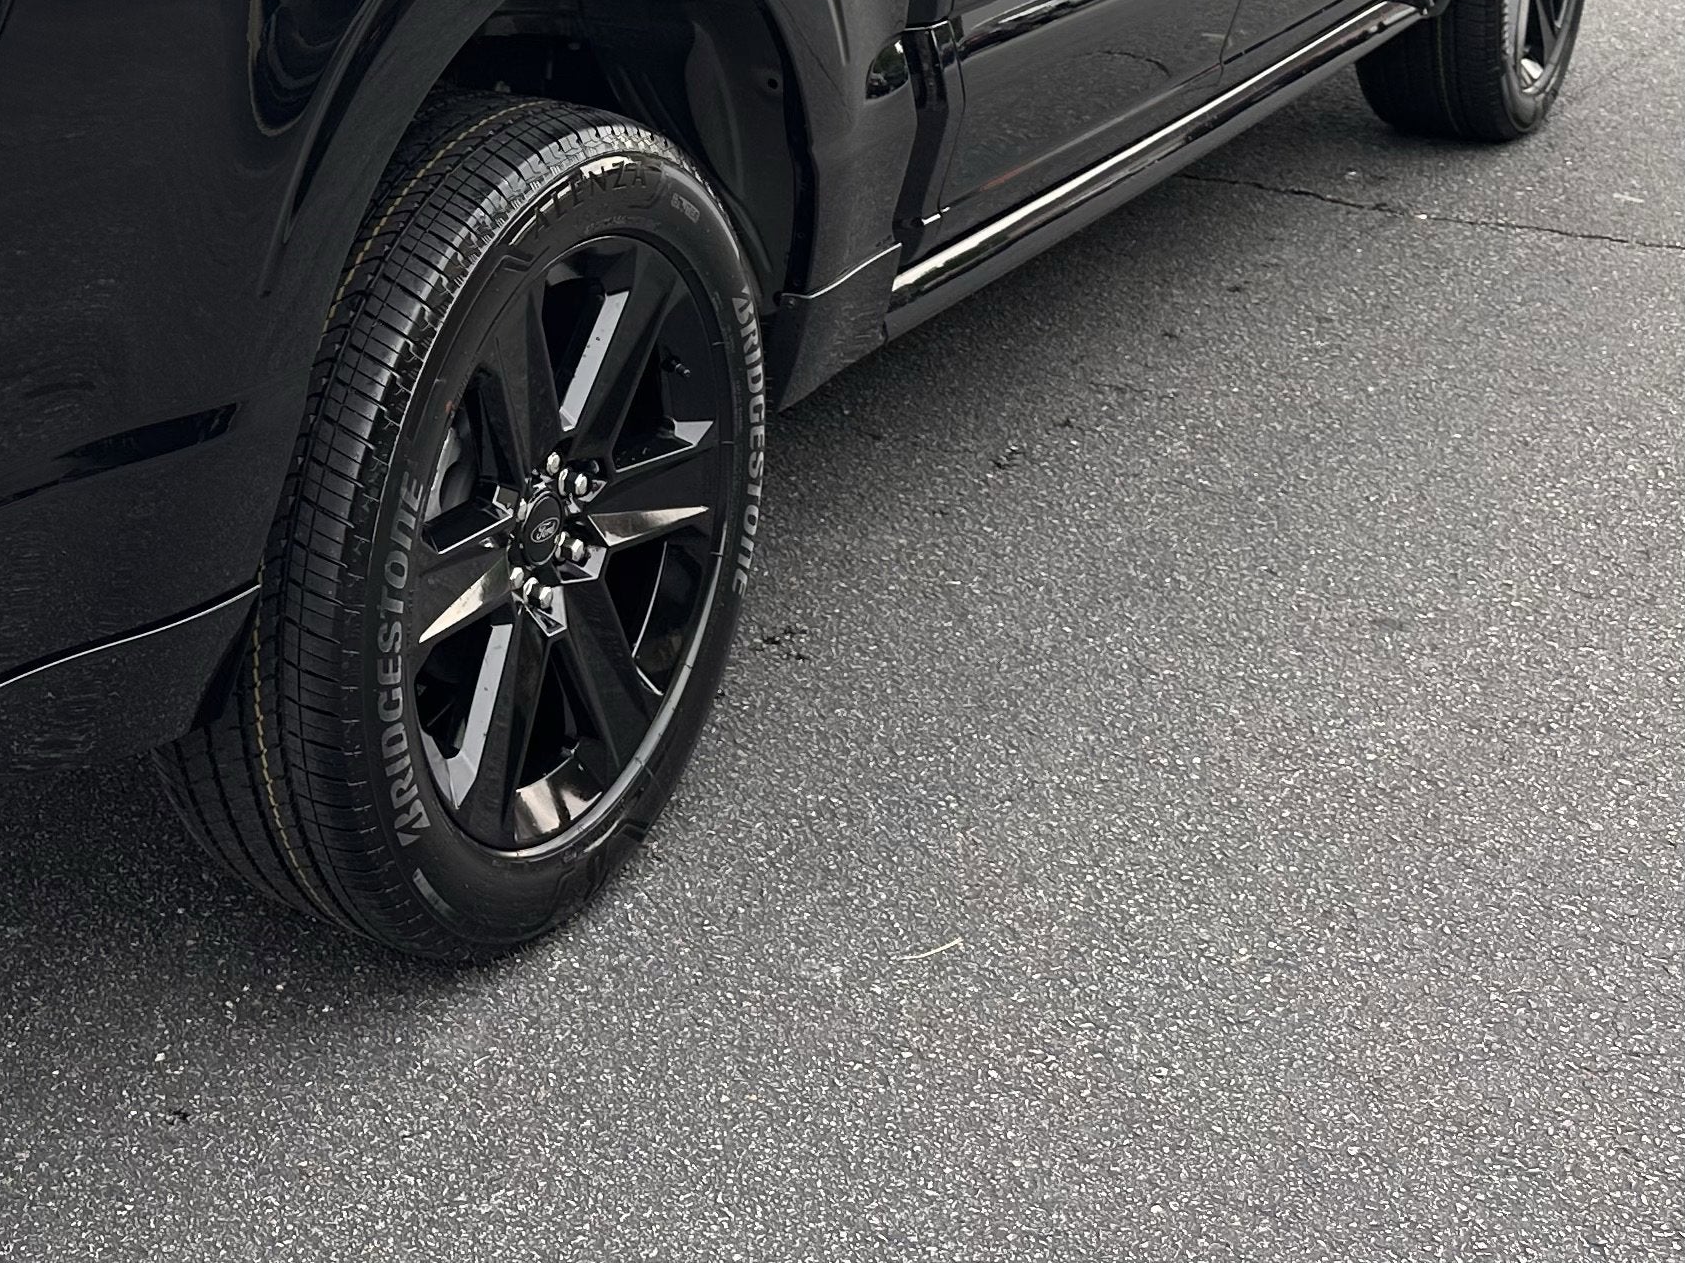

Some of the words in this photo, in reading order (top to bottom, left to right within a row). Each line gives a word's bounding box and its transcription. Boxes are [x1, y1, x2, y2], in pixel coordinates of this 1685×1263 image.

[533, 160, 648, 239] ALENZA
[732, 285, 766, 598] BRIDGESTONE
[377, 471, 432, 848] BRIDGESTONE
